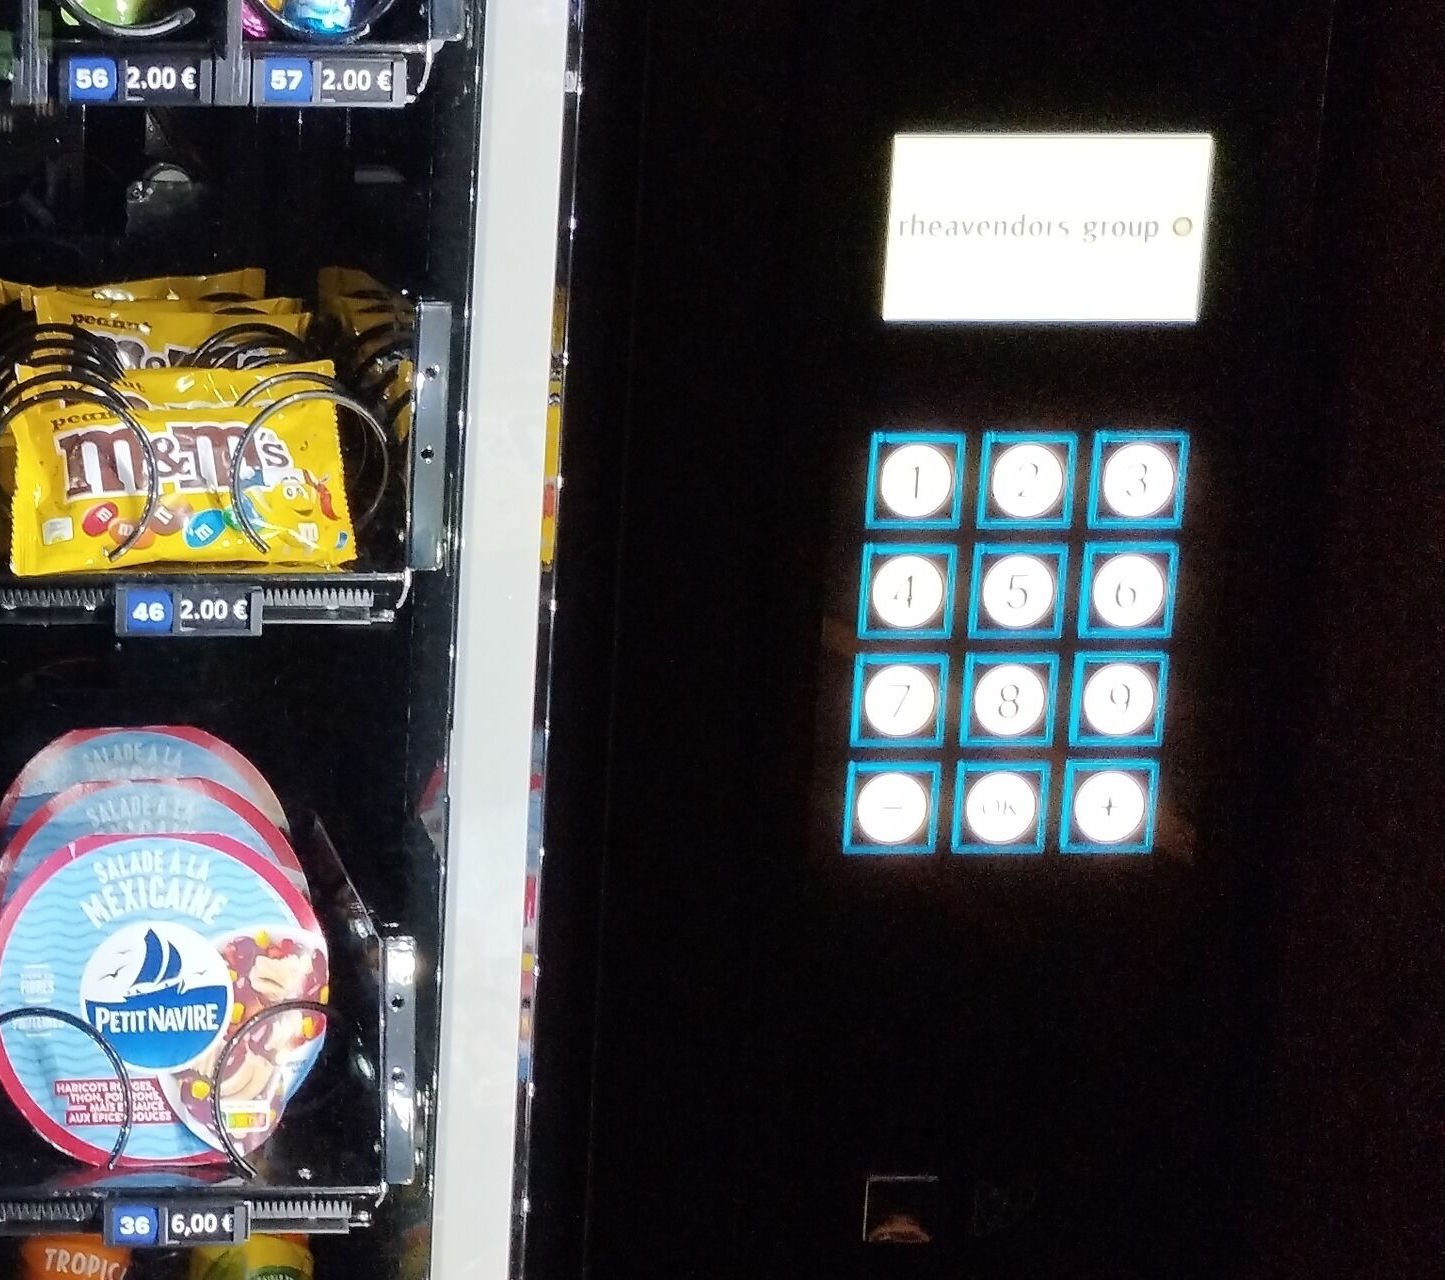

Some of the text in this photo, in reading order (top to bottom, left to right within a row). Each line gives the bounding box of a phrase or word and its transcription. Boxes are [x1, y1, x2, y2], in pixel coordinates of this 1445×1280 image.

[74, 68, 109, 89] 56
[181, 67, 197, 90] €
[270, 69, 303, 91] 57
[376, 69, 392, 91] €
[898, 213, 1159, 244] rheavendors group
[910, 464, 920, 499] 1
[1017, 462, 1040, 499] 2
[1124, 462, 1148, 499] 3
[892, 574, 914, 609] 4
[1005, 574, 1030, 610] 5
[1114, 578, 1137, 609] 6
[131, 603, 165, 622] 46
[233, 600, 248, 621] €
[890, 683, 912, 718] 7
[997, 683, 1021, 719] 8
[1109, 682, 1132, 715] 9
[92, 848, 210, 884] SALADE LA
[78, 875, 229, 930] MEXICAINE
[95, 1005, 147, 1035] PETIT
[147, 1003, 219, 1033] NAVIRE
[118, 1213, 217, 1236] 36 6,00
